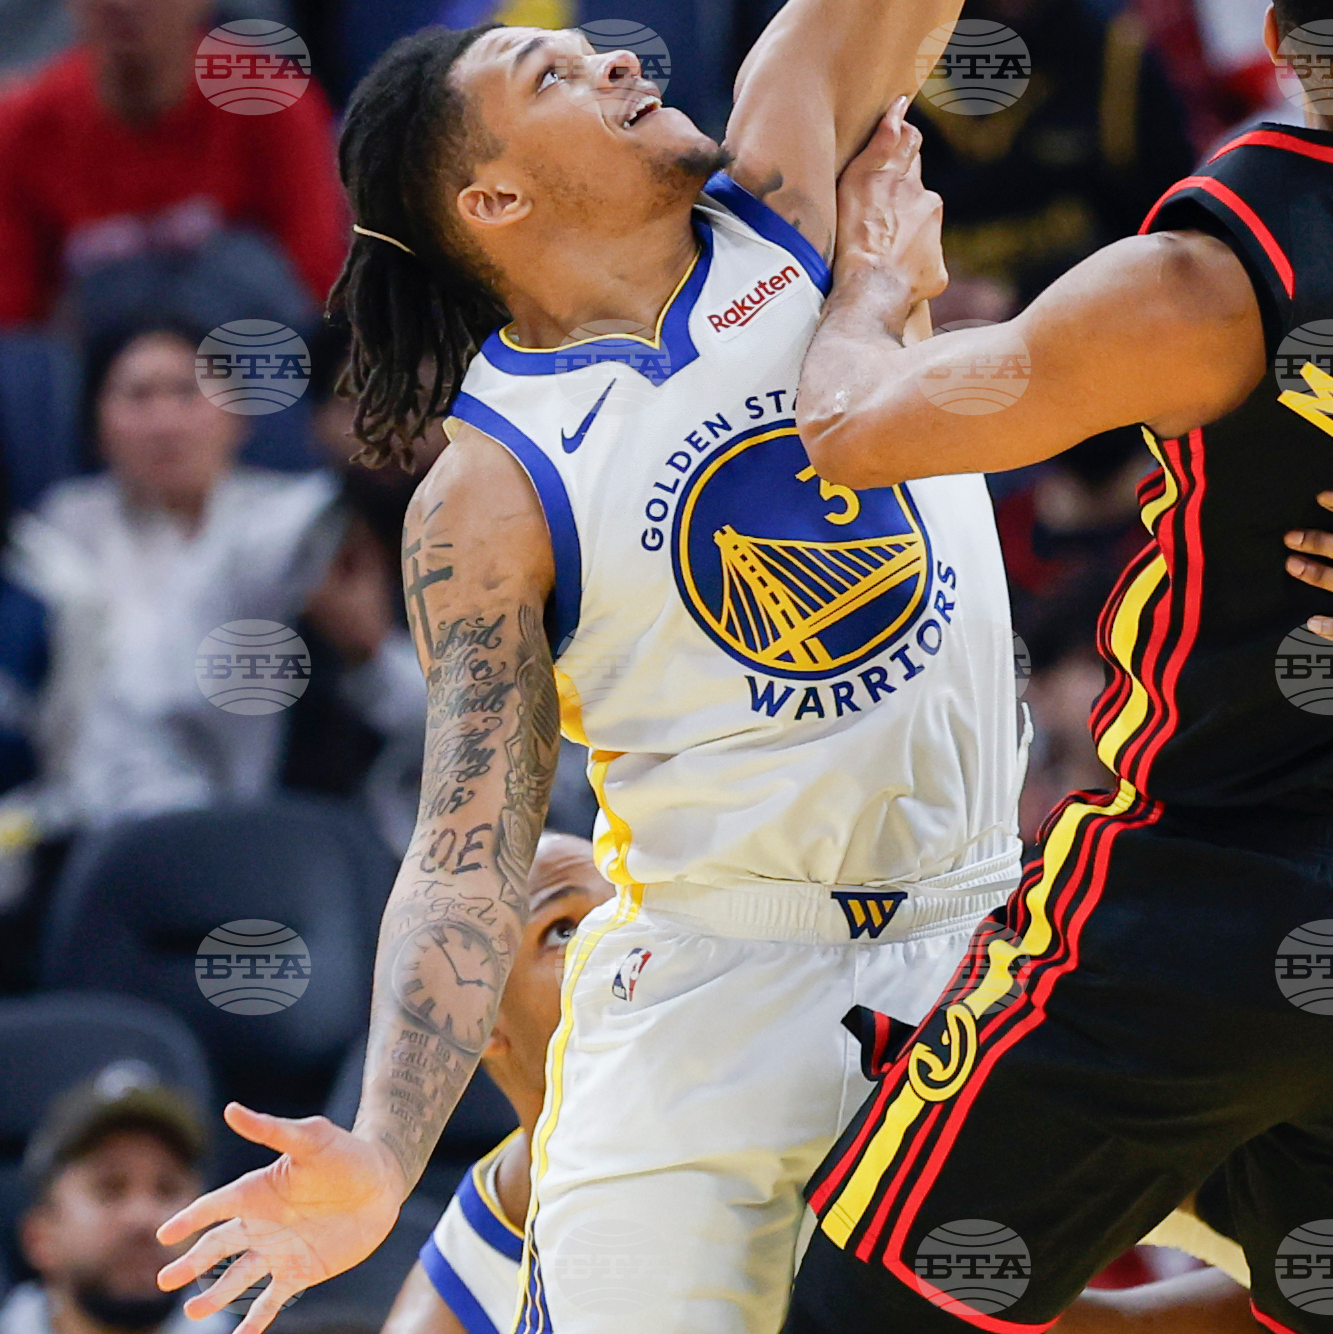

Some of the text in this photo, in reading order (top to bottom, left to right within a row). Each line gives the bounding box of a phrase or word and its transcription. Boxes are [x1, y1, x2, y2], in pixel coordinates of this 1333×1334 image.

[706, 265, 800, 333] Rakuten
[641, 413, 733, 552] GOLDEN
[744, 561, 957, 721] WARRIORS
[830, 890, 908, 939] W
